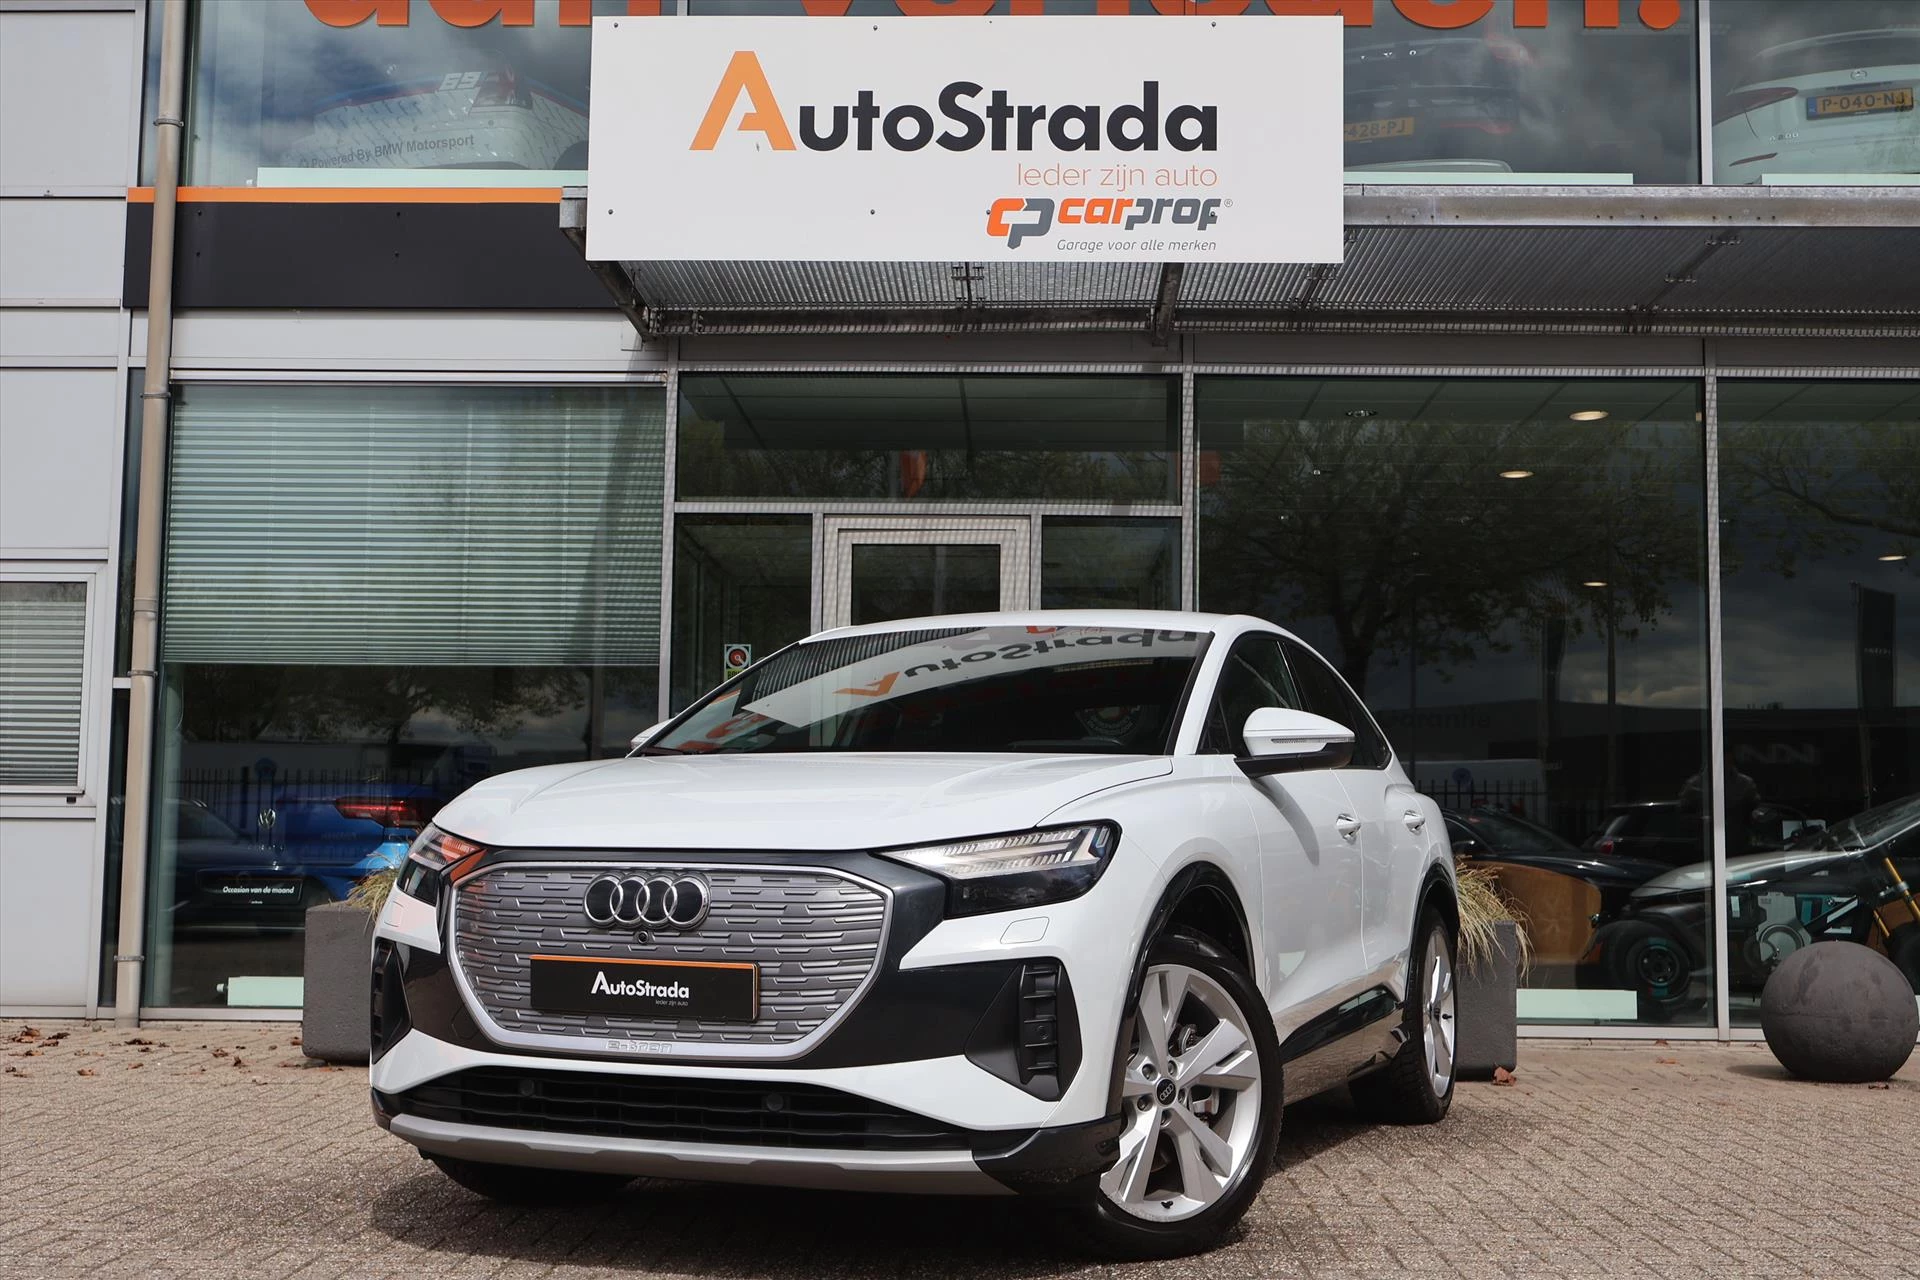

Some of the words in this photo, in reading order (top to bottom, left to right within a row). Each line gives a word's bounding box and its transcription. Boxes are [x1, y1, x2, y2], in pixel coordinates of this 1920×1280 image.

[689, 51, 1217, 152] AutoStrada
[356, 149, 371, 161] By
[374, 143, 404, 156] BMW
[406, 134, 475, 152] Motorsport
[1017, 163, 1092, 186] Ieder
[1101, 164, 1145, 192] zijn
[1155, 165, 1218, 187] auto
[1057, 239, 1104, 253] Garage
[1107, 240, 1137, 251] voor
[1140, 239, 1165, 251] alle
[1168, 239, 1217, 251] merken
[222, 885, 249, 894] Occasion
[250, 886, 262, 894] van
[263, 885, 271, 894] de
[591, 971, 690, 999] AutoStrada
